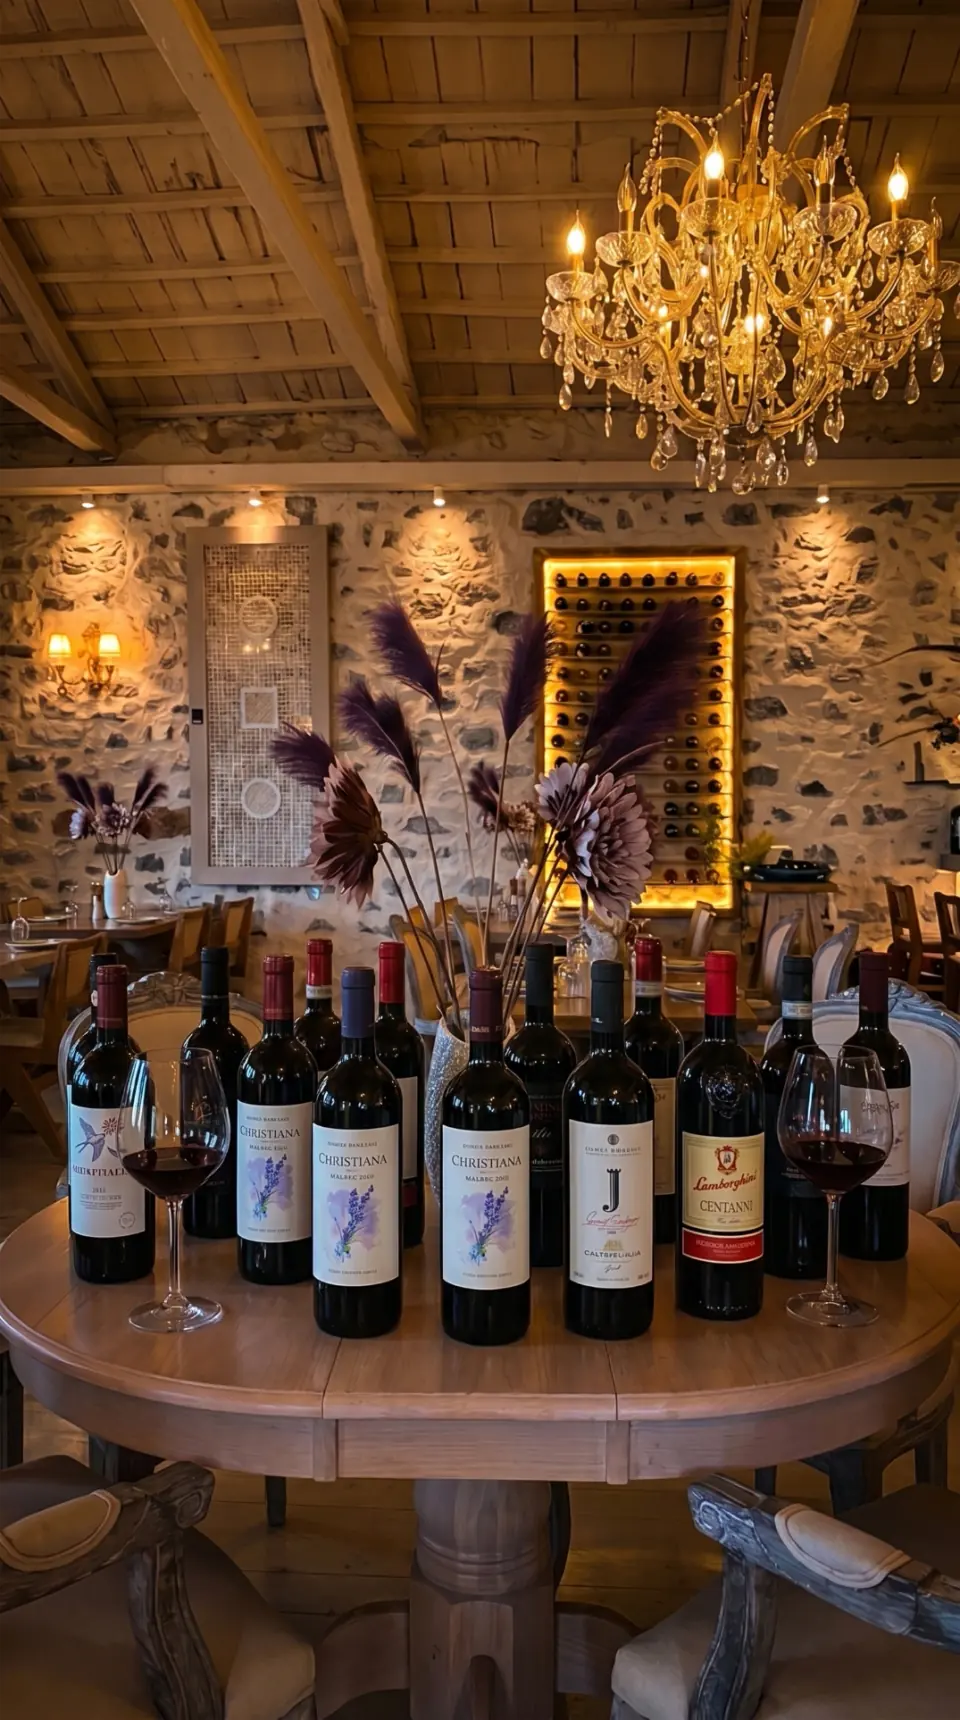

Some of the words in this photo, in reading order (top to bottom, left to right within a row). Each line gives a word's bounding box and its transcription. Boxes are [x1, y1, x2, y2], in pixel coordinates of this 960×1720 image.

[240, 1125, 301, 1139] CHRISTIANA
[318, 1152, 388, 1167] CHRISTIANA
[451, 1154, 522, 1169] CHRISTIANA
[692, 1170, 759, 1192] Lamborghini
[602, 1168, 622, 1213] J
[700, 1200, 753, 1213] CENTANNI
